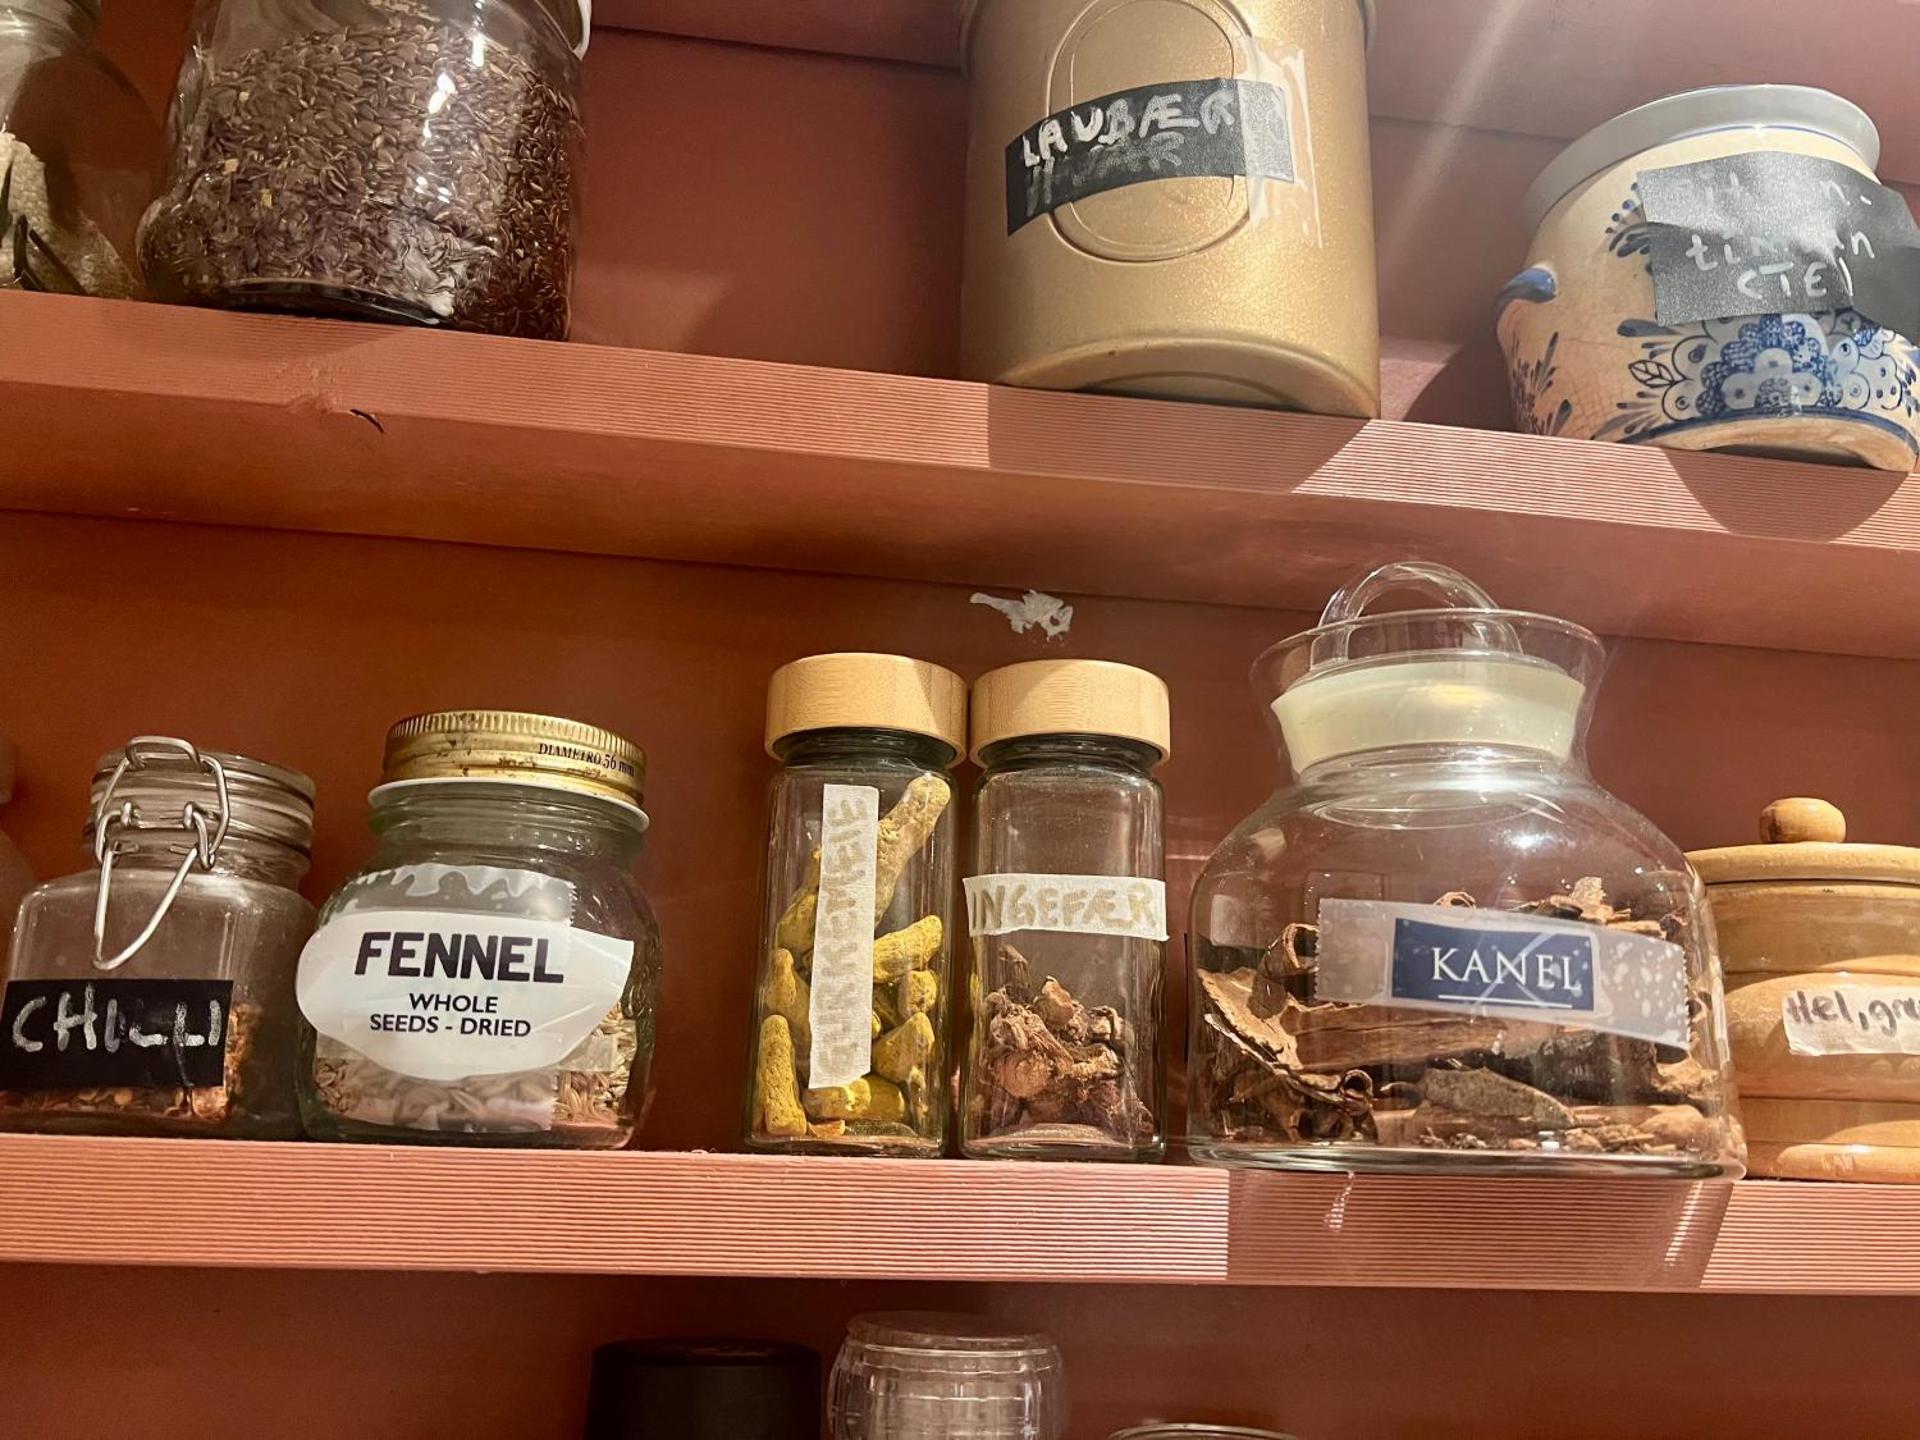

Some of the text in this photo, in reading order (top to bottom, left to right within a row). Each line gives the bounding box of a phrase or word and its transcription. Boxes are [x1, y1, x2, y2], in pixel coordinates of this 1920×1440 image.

[603, 753, 617, 771] 56
[354, 931, 565, 984] FENNEL
[1431, 947, 1583, 993] KANEL
[409, 992, 499, 1014] WHOLE
[370, 1013, 440, 1033] SEEDS
[460, 1017, 532, 1038] DRIED
